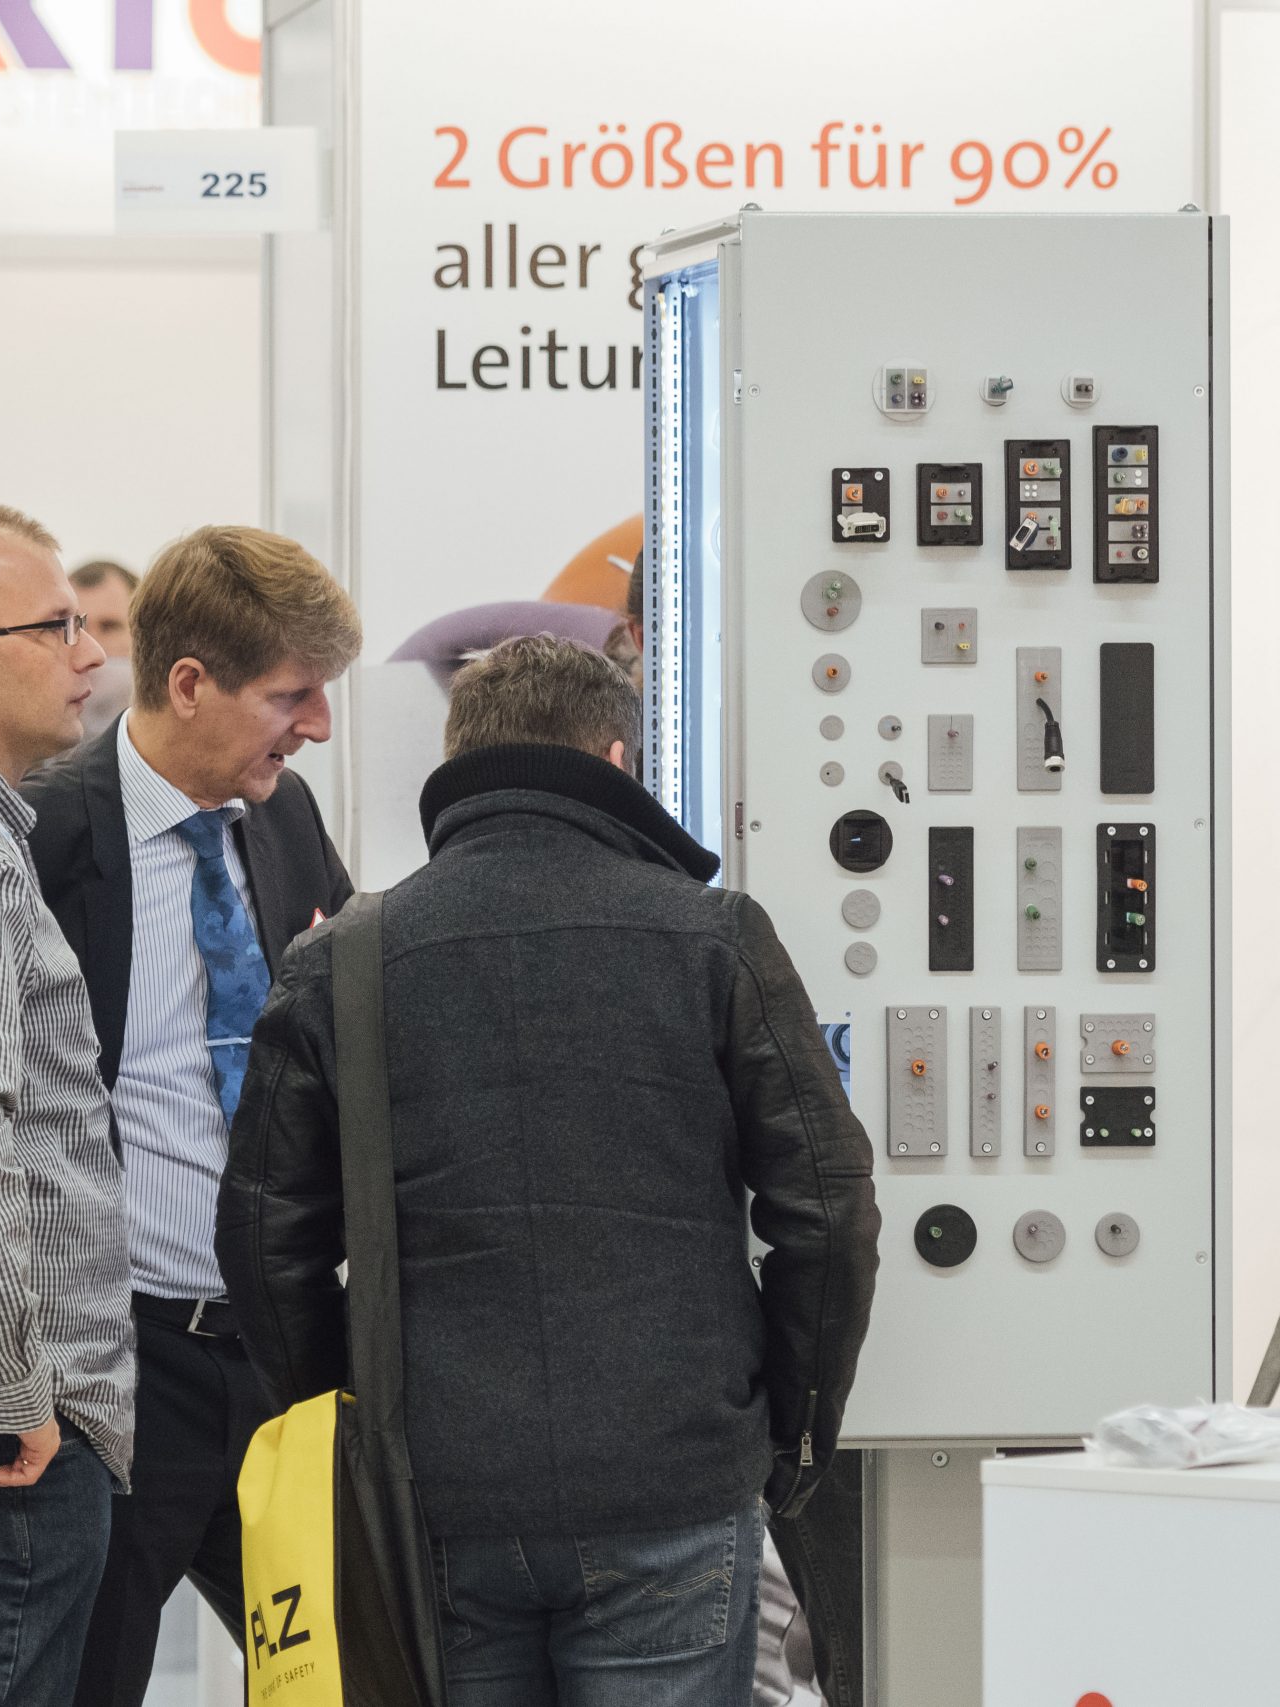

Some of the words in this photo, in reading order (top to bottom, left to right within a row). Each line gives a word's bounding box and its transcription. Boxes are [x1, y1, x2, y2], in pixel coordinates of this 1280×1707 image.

[201, 172, 268, 198] 225
[433, 126, 471, 188] 2
[497, 121, 784, 189] Größen
[811, 121, 925, 189] für
[950, 126, 1119, 206] 90%
[433, 223, 601, 289] aller
[284, 1661, 316, 1684] SAFETY
